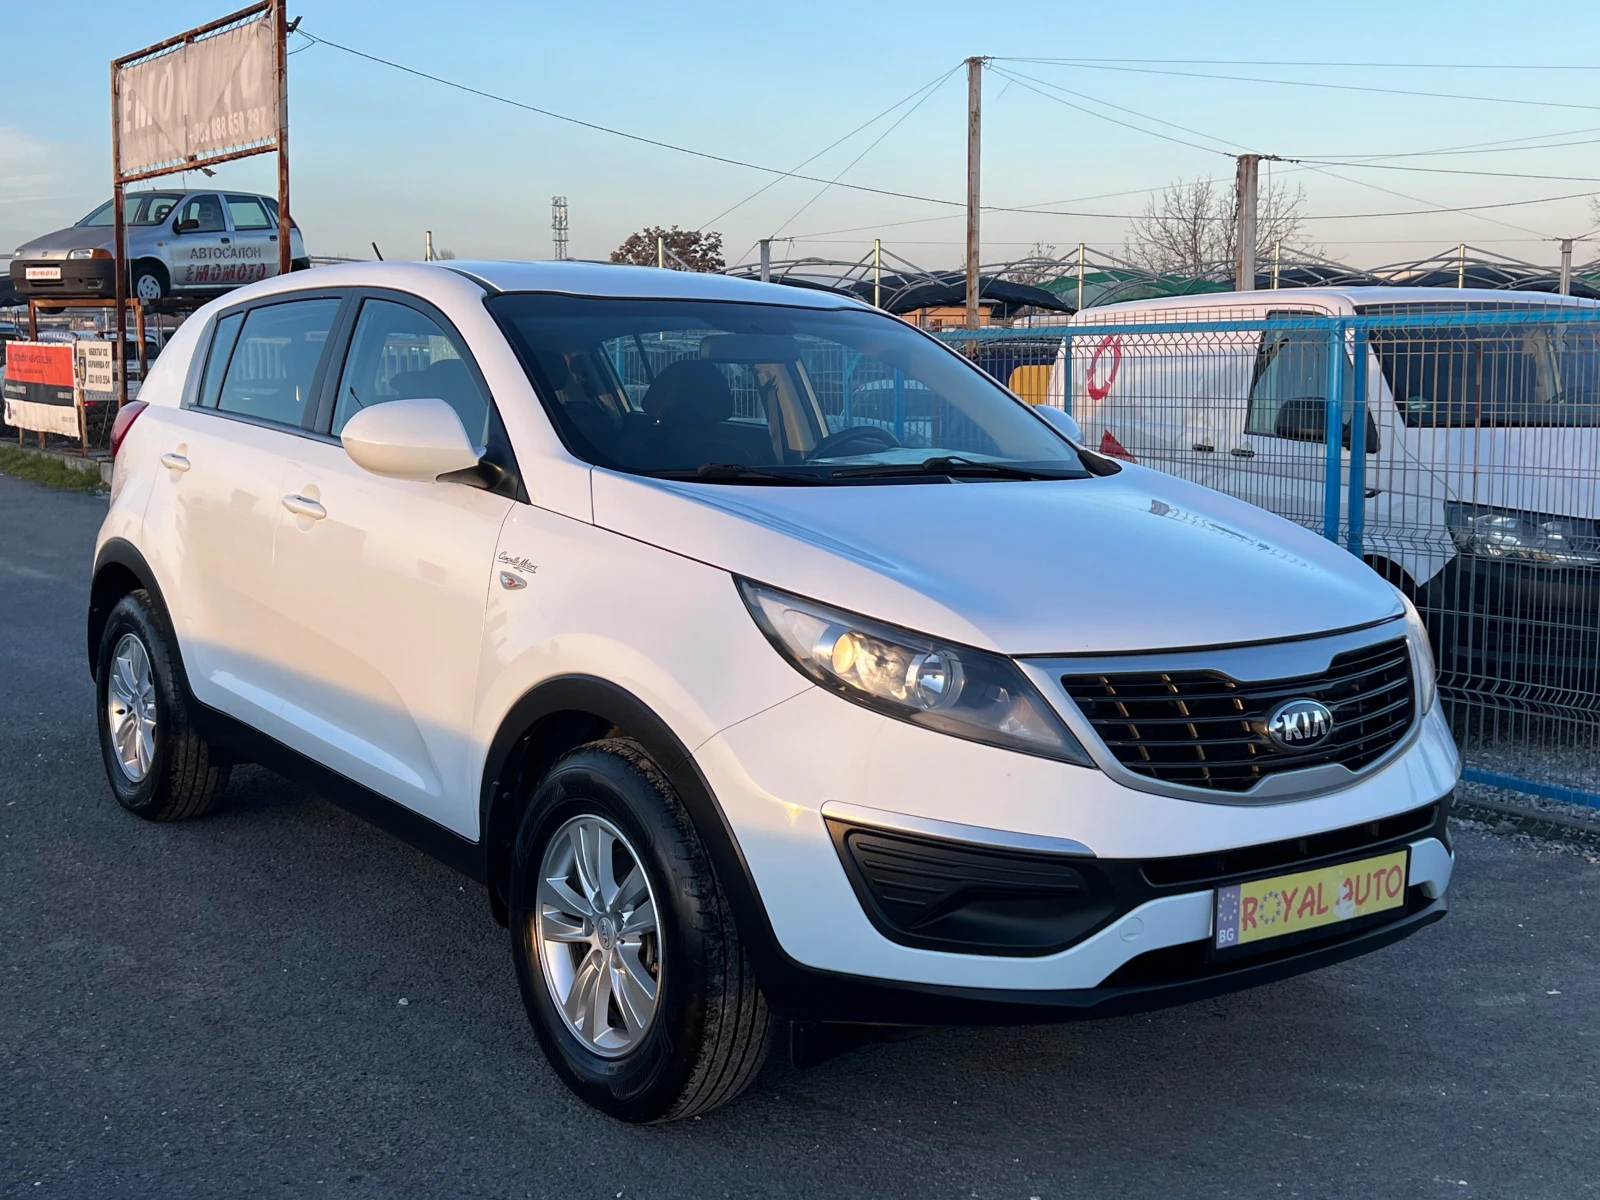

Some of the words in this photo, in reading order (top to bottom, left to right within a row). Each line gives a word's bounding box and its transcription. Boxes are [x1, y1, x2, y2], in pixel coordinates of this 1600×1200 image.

[211, 115, 227, 140] 888
[246, 106, 267, 132] 297
[189, 246, 262, 260] АВТОСАЛОН
[1280, 709, 1327, 741] KIA
[1336, 864, 1404, 912] AUTO
[1218, 928, 1235, 944] BG
